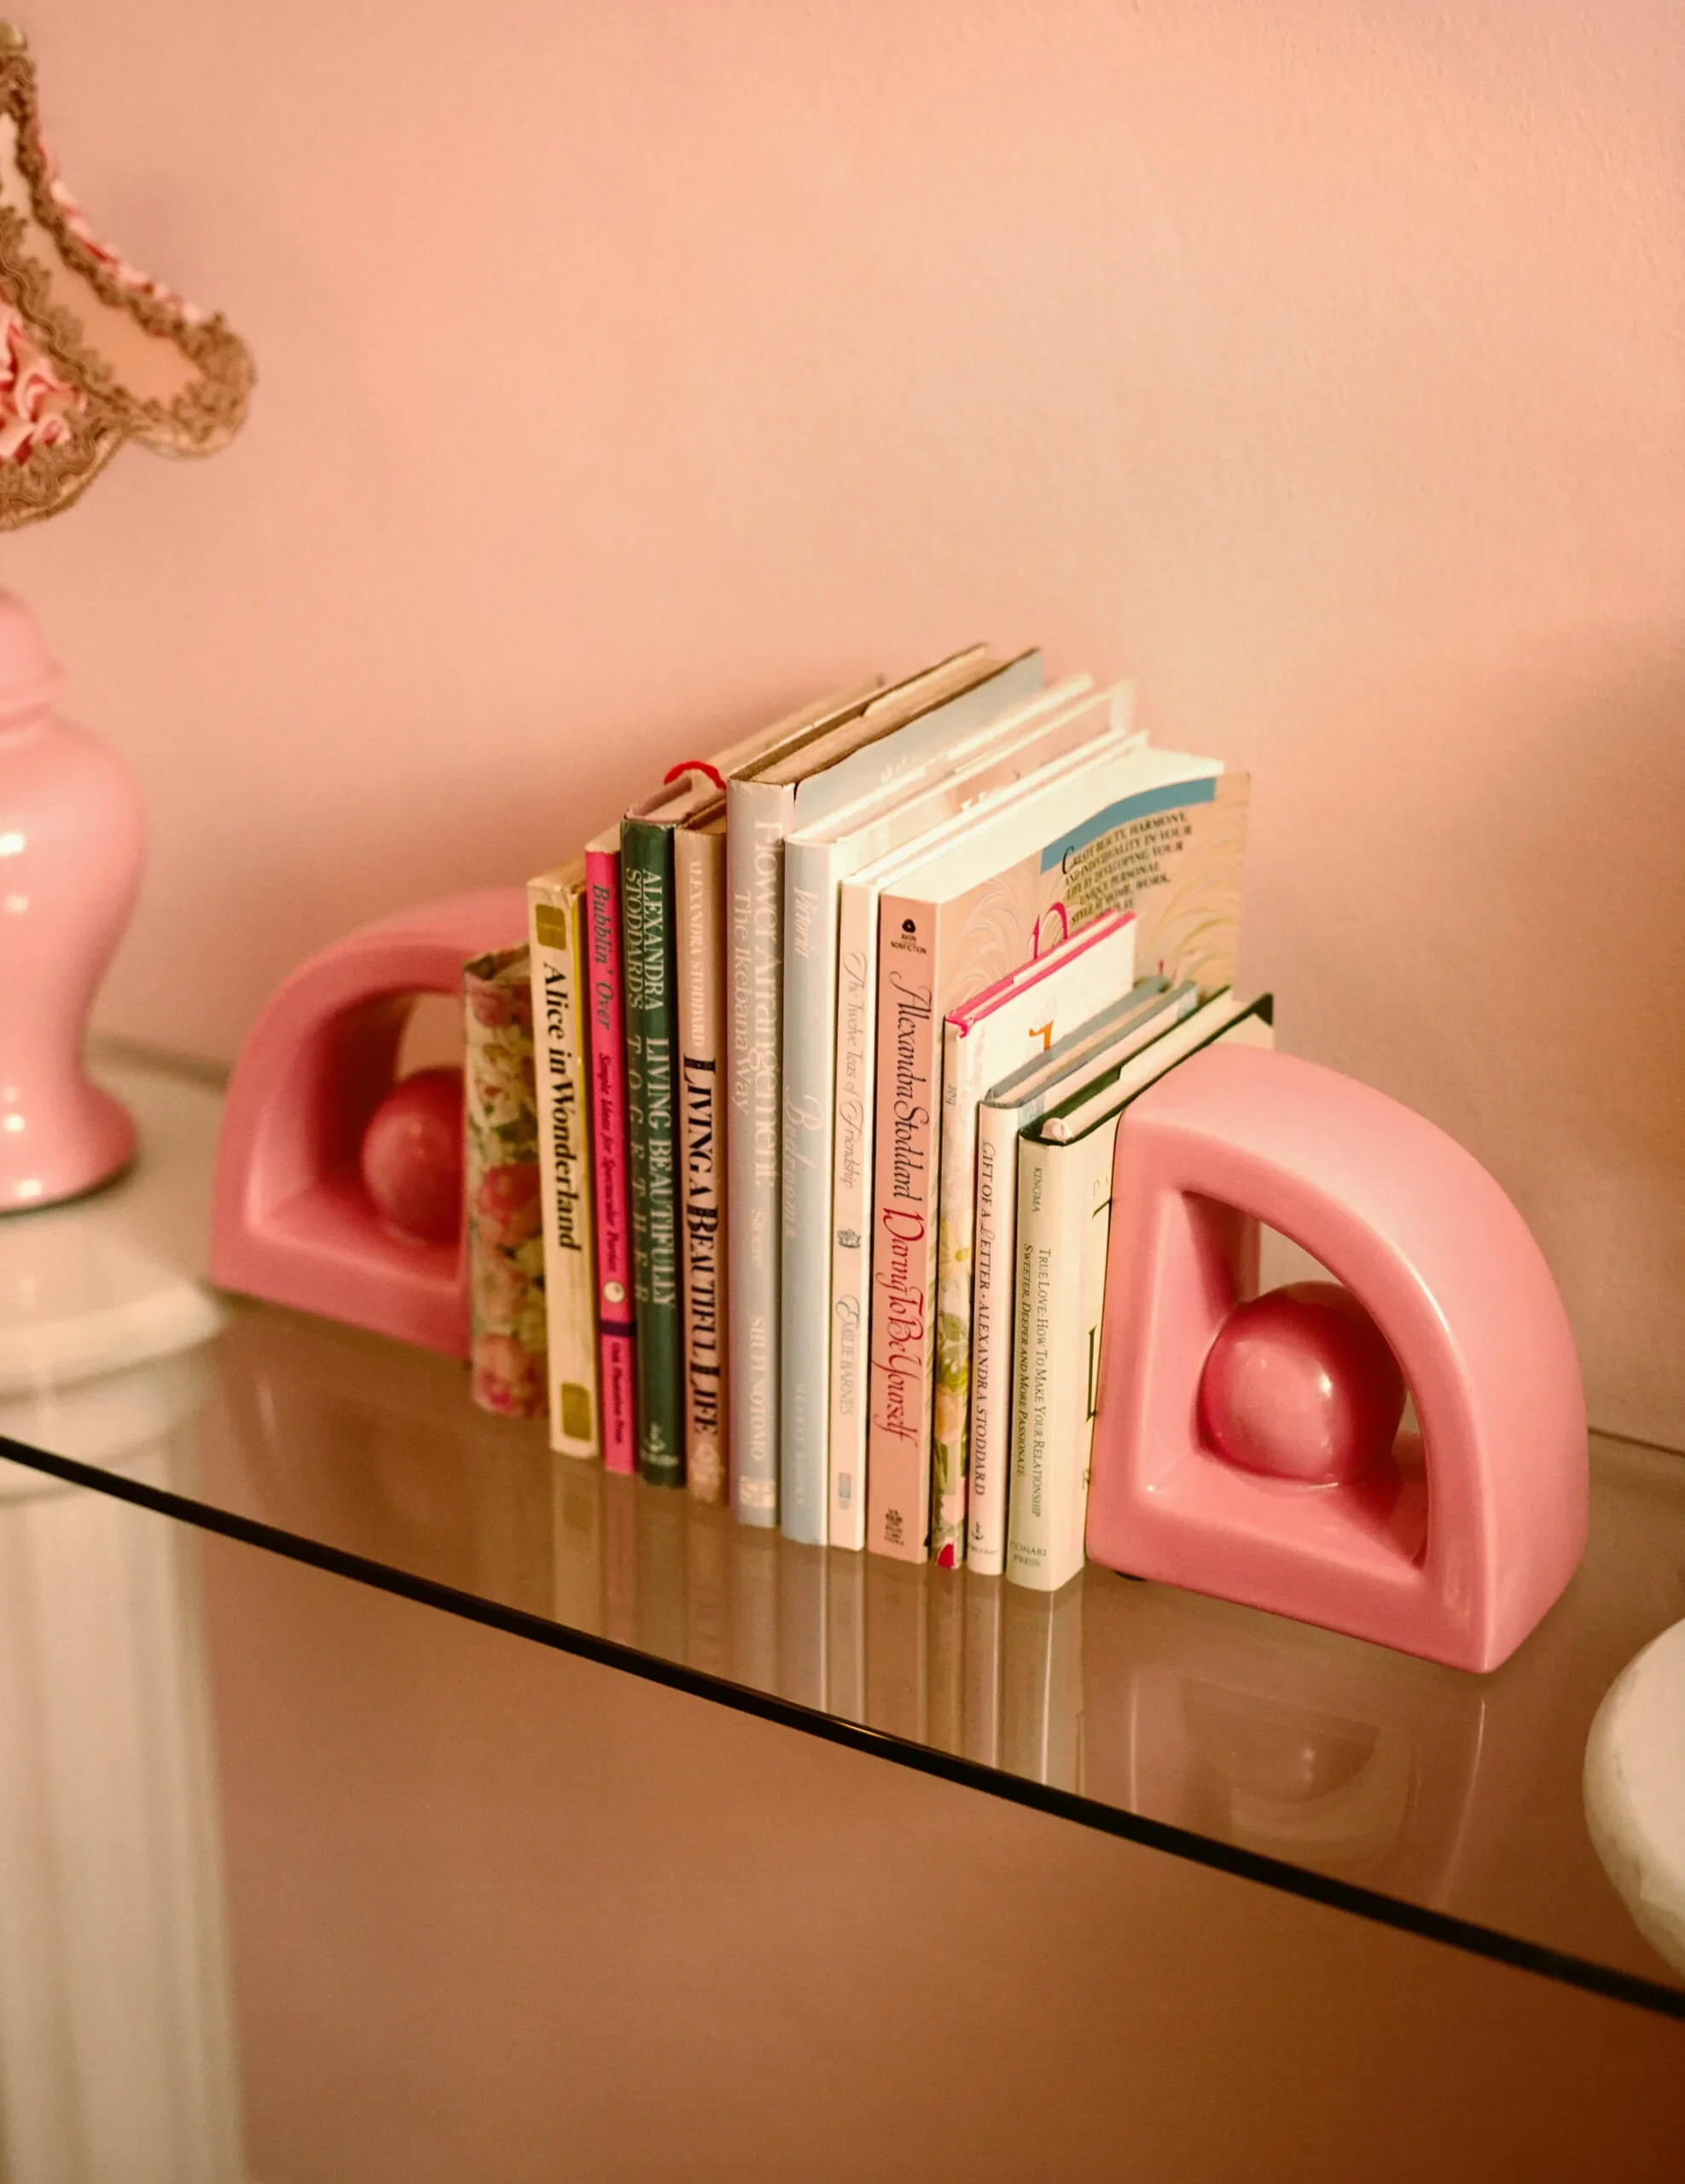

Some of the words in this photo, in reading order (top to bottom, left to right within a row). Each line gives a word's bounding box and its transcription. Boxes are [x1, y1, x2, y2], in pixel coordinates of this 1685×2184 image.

[754, 820, 783, 941] Flower
[592, 884, 614, 975] Bubblin'
[642, 868, 665, 1011] ALEXANDRA
[735, 890, 752, 943] The
[793, 886, 819, 960] Victoria
[543, 961, 570, 1041] Alice
[735, 947, 753, 1050] Ikebana
[842, 950, 868, 998] The
[597, 982, 615, 1031] Over
[845, 1001, 865, 1043] Twelve
[548, 1048, 572, 1076] in
[845, 1048, 864, 1077] Teas
[889, 971, 932, 1100] Alexandra
[646, 1037, 673, 1130] LIVING
[731, 1054, 752, 1116] Way
[843, 1081, 860, 1097] of
[683, 1052, 717, 1175] LIVING
[551, 1079, 584, 1252] Wonderland
[601, 1132, 615, 1153] for
[840, 1100, 865, 1190] Friendship
[893, 1100, 930, 1202] Stoddard
[980, 1140, 996, 1182] GIFT
[689, 1177, 713, 1199] A
[981, 1183, 993, 1206] OF
[981, 1210, 991, 1218] A
[1031, 1166, 1043, 1213] KINGMA
[649, 1136, 677, 1309] BEAUTIFULLY
[686, 1202, 719, 1358] BEAUTIFUL
[875, 1207, 925, 1298] Daring
[979, 1223, 996, 1290] LETTER
[1038, 1248, 1051, 1280] TRUE
[835, 1294, 861, 1356] EMILIE
[887, 1286, 924, 1318] To
[1020, 1301, 1031, 1345] DEEPER
[886, 1316, 924, 1352] Be
[976, 1301, 990, 1400] ALEXANDRA
[1020, 1345, 1029, 1372] AND
[1035, 1350, 1048, 1366] TO
[1036, 1317, 1049, 1347] HOW
[690, 1360, 722, 1438] LIFE
[840, 1359, 856, 1416] BARNES
[872, 1354, 922, 1449] Yourself
[1019, 1374, 1030, 1408] MORE
[1034, 1368, 1047, 1403] MAKE
[1017, 1408, 1029, 1478] PASSIONATE
[1033, 1405, 1046, 1438] YOUR
[974, 1405, 988, 1496] STODDARD
[1031, 1439, 1045, 1518] RELATIONSHIP
[1009, 1540, 1048, 1557] CONARI
